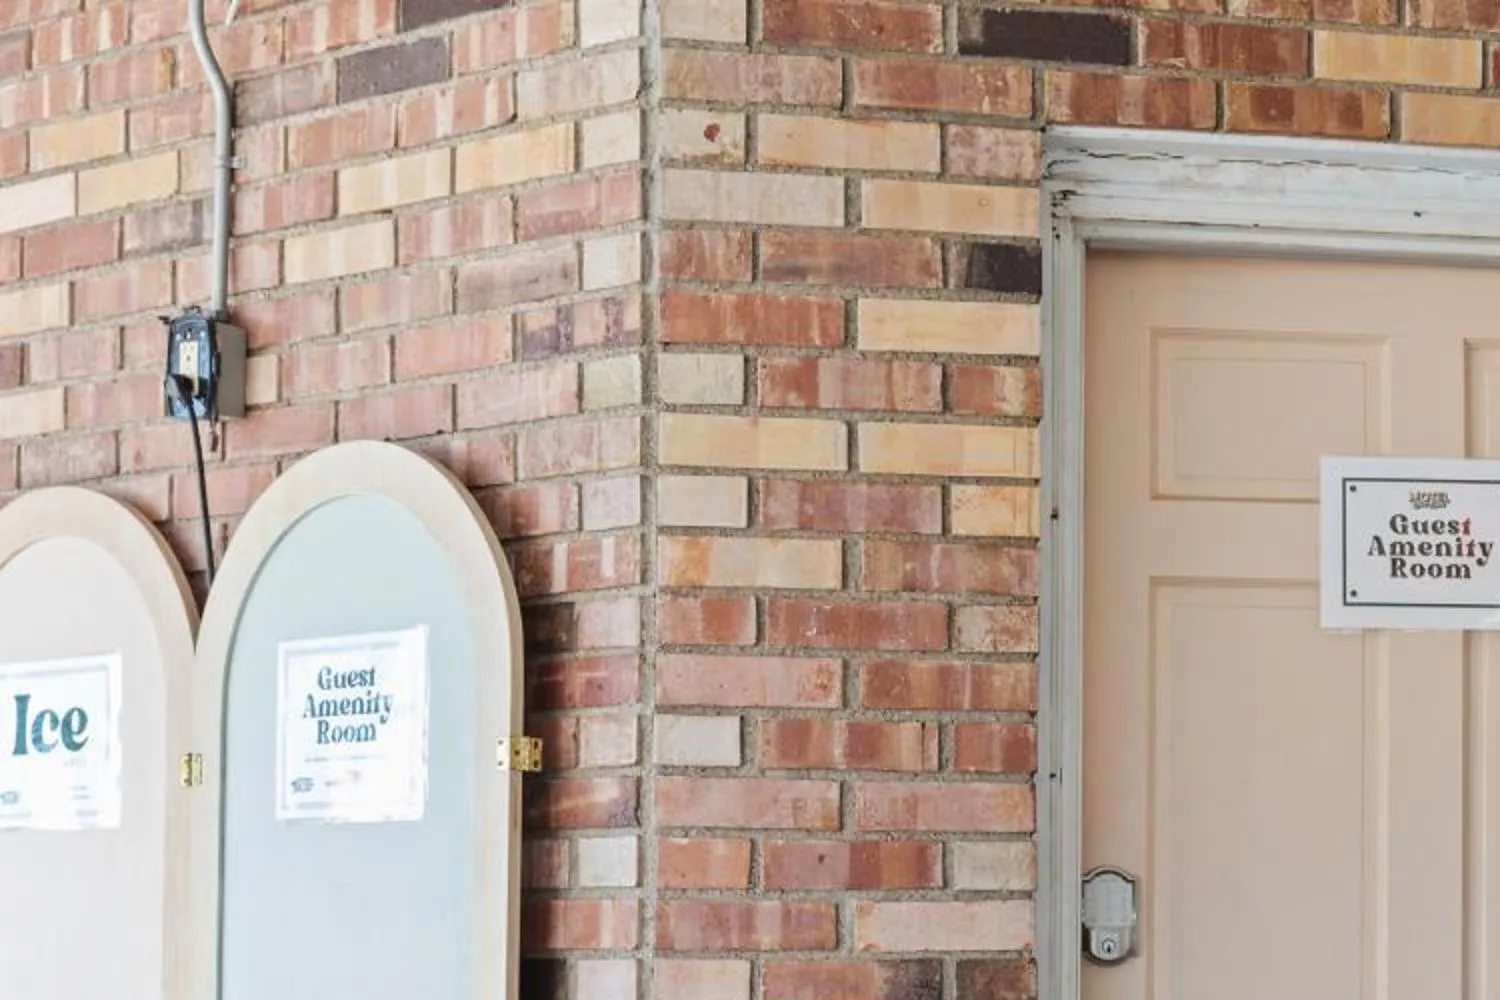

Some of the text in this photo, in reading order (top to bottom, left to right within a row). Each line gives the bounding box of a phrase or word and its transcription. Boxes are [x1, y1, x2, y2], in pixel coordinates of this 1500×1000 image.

[1389, 513, 1472, 536] Guest
[1367, 535, 1494, 567] Amenity
[1389, 558, 1472, 580] Room
[317, 665, 376, 691] Guest
[302, 690, 395, 725] Amenity
[12, 693, 90, 756] Ice
[315, 718, 377, 745] Room
